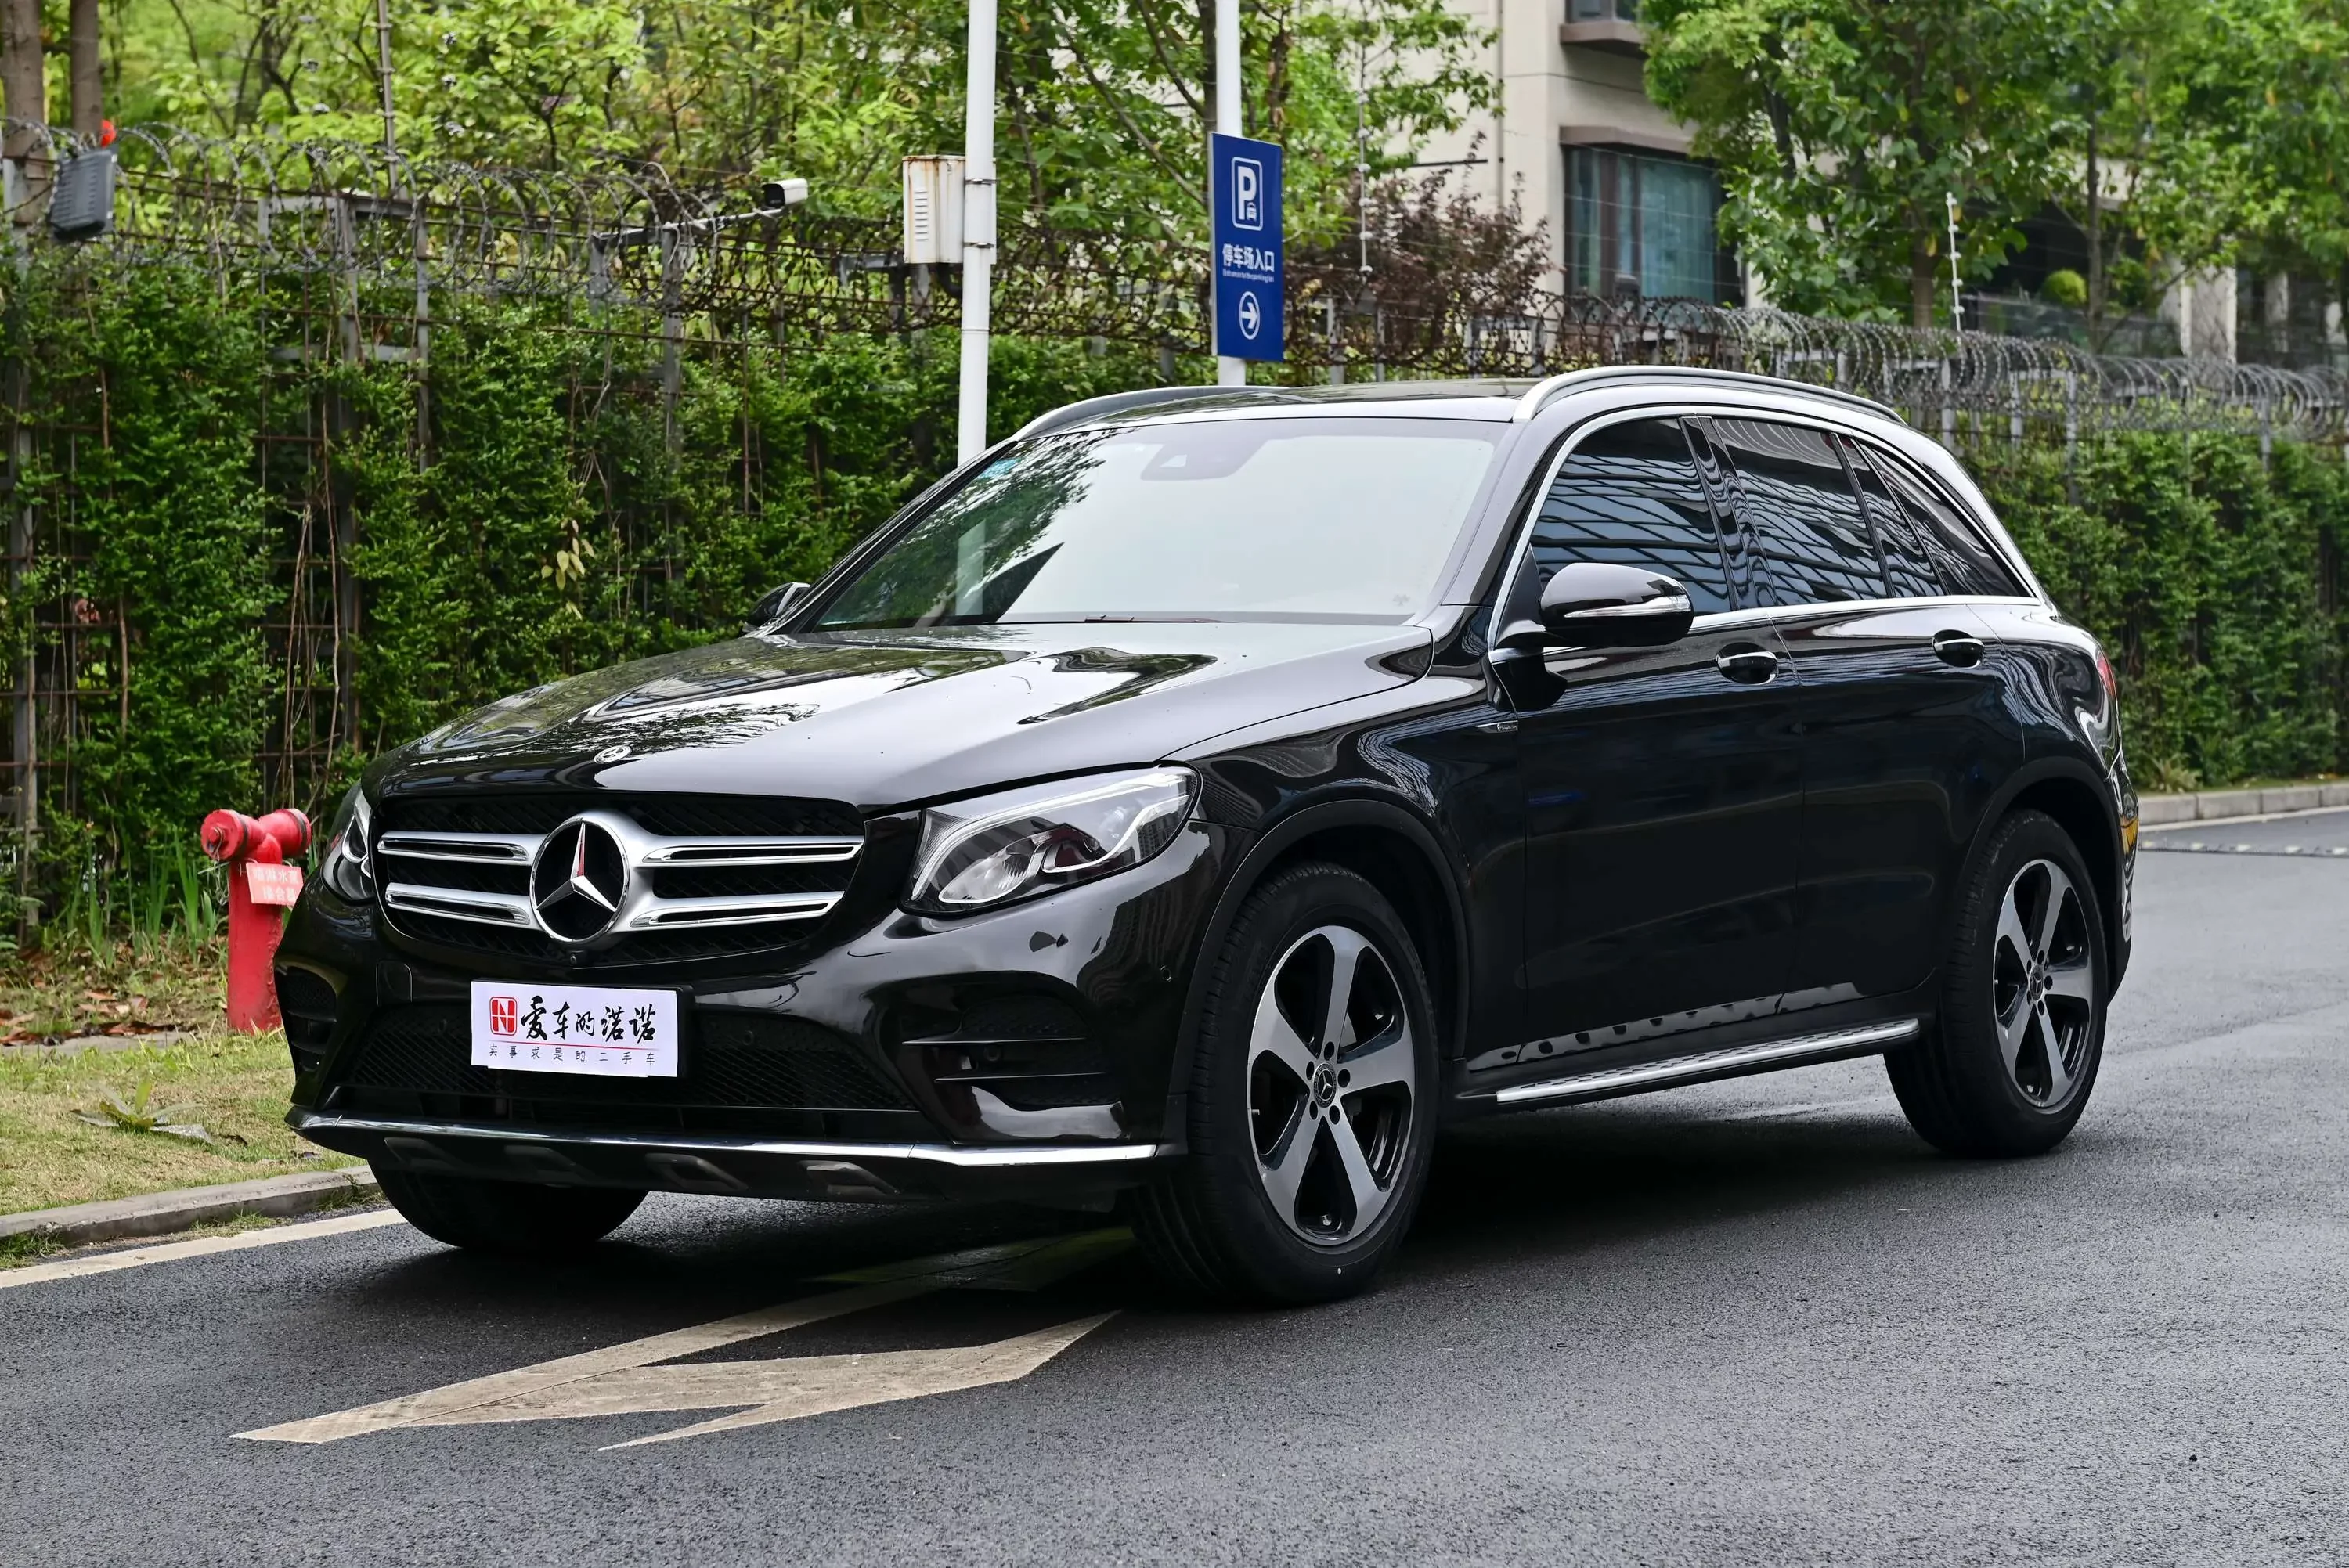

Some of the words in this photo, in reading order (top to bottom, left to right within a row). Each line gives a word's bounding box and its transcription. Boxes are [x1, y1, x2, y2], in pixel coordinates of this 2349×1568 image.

[1237, 165, 1257, 220] P
[1222, 243, 1275, 272] 停车场入口
[489, 1044, 655, 1065] 实事求是的二手车
